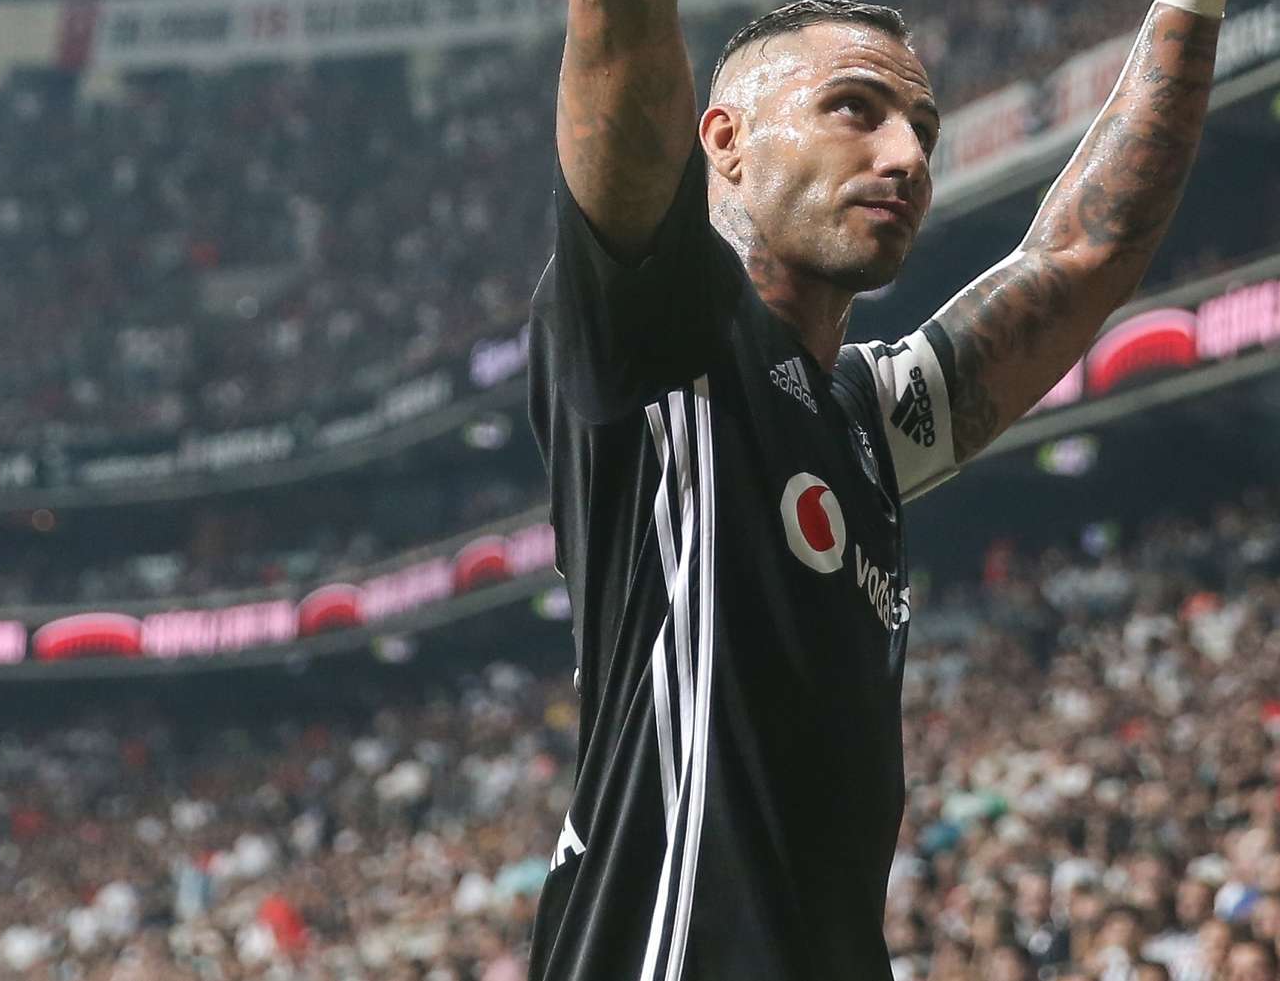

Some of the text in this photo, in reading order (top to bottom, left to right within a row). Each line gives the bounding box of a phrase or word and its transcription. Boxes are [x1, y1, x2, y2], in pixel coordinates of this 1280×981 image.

[769, 370, 818, 414] adidas
[909, 366, 936, 448] adidas
[855, 543, 910, 634] voda
